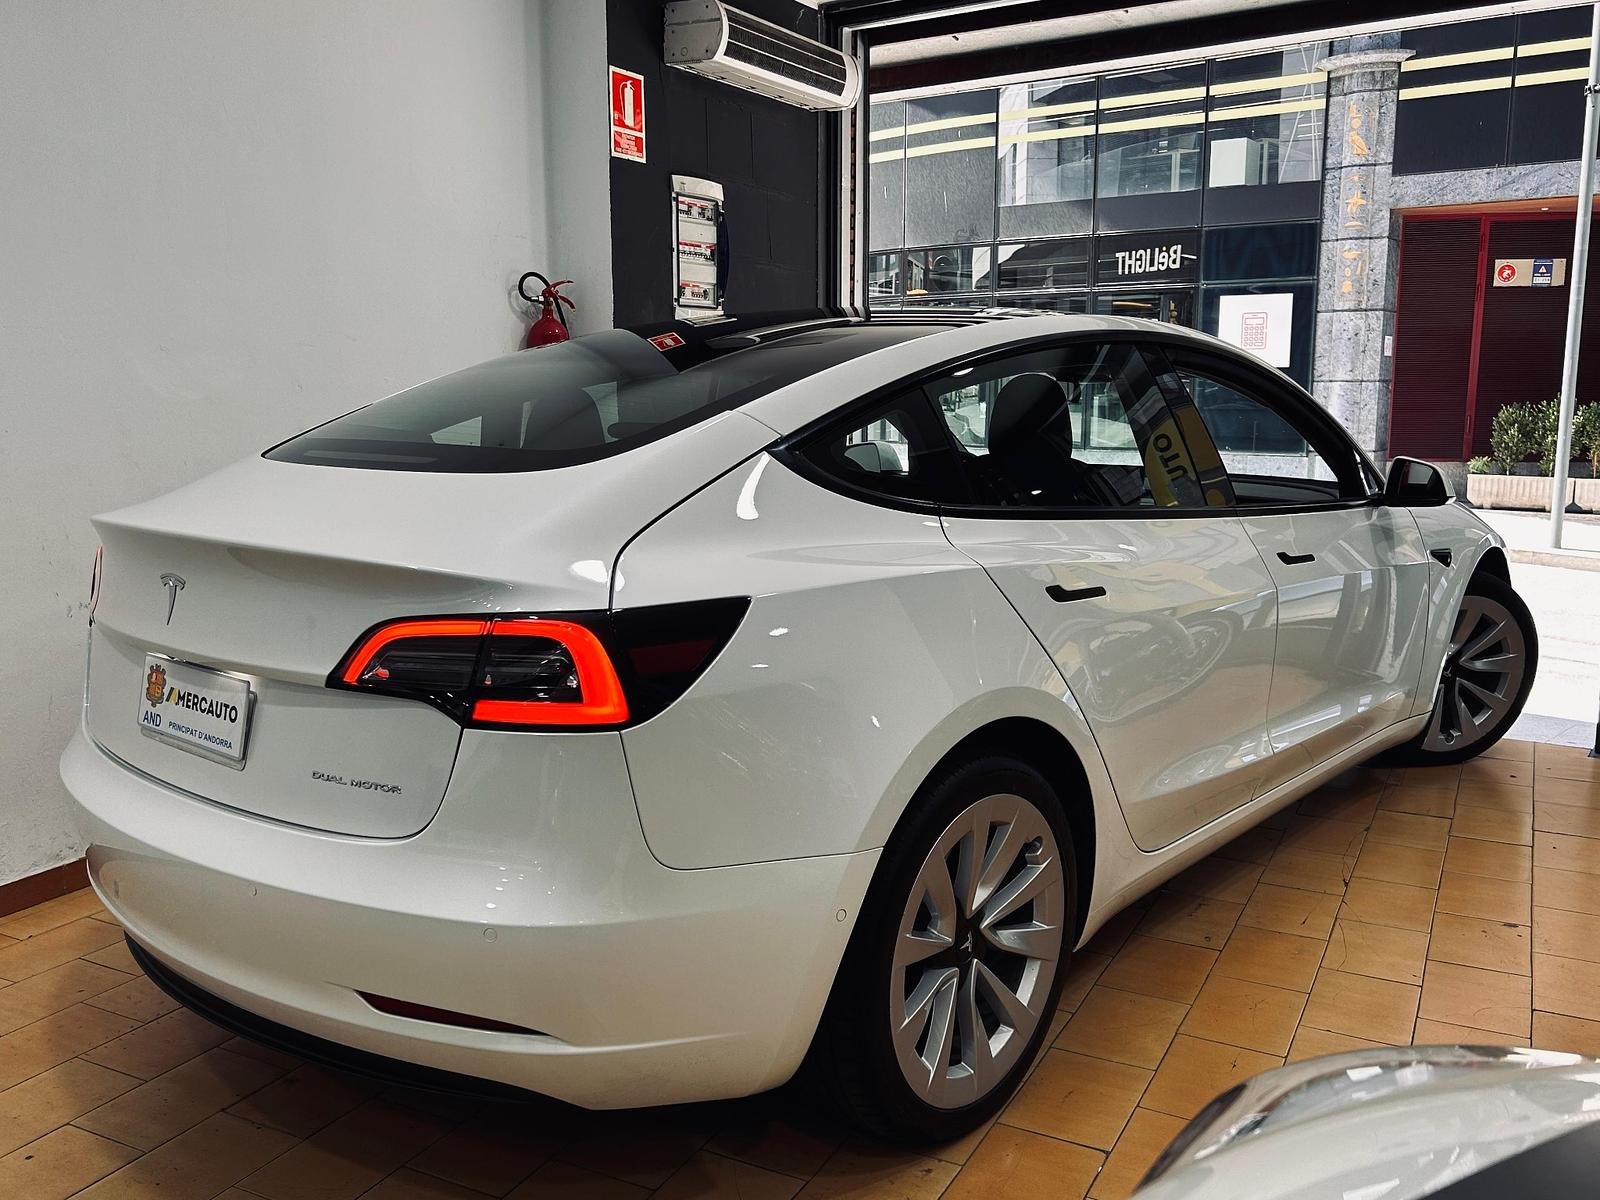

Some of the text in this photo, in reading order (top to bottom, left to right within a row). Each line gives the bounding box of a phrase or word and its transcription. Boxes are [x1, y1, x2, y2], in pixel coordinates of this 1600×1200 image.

[143, 710, 161, 727] AND
[175, 689, 238, 723] MERCAUTO
[169, 721, 232, 749] PRINCIPAT D'ANDORRA
[312, 770, 402, 795] DUAL MOTOR
